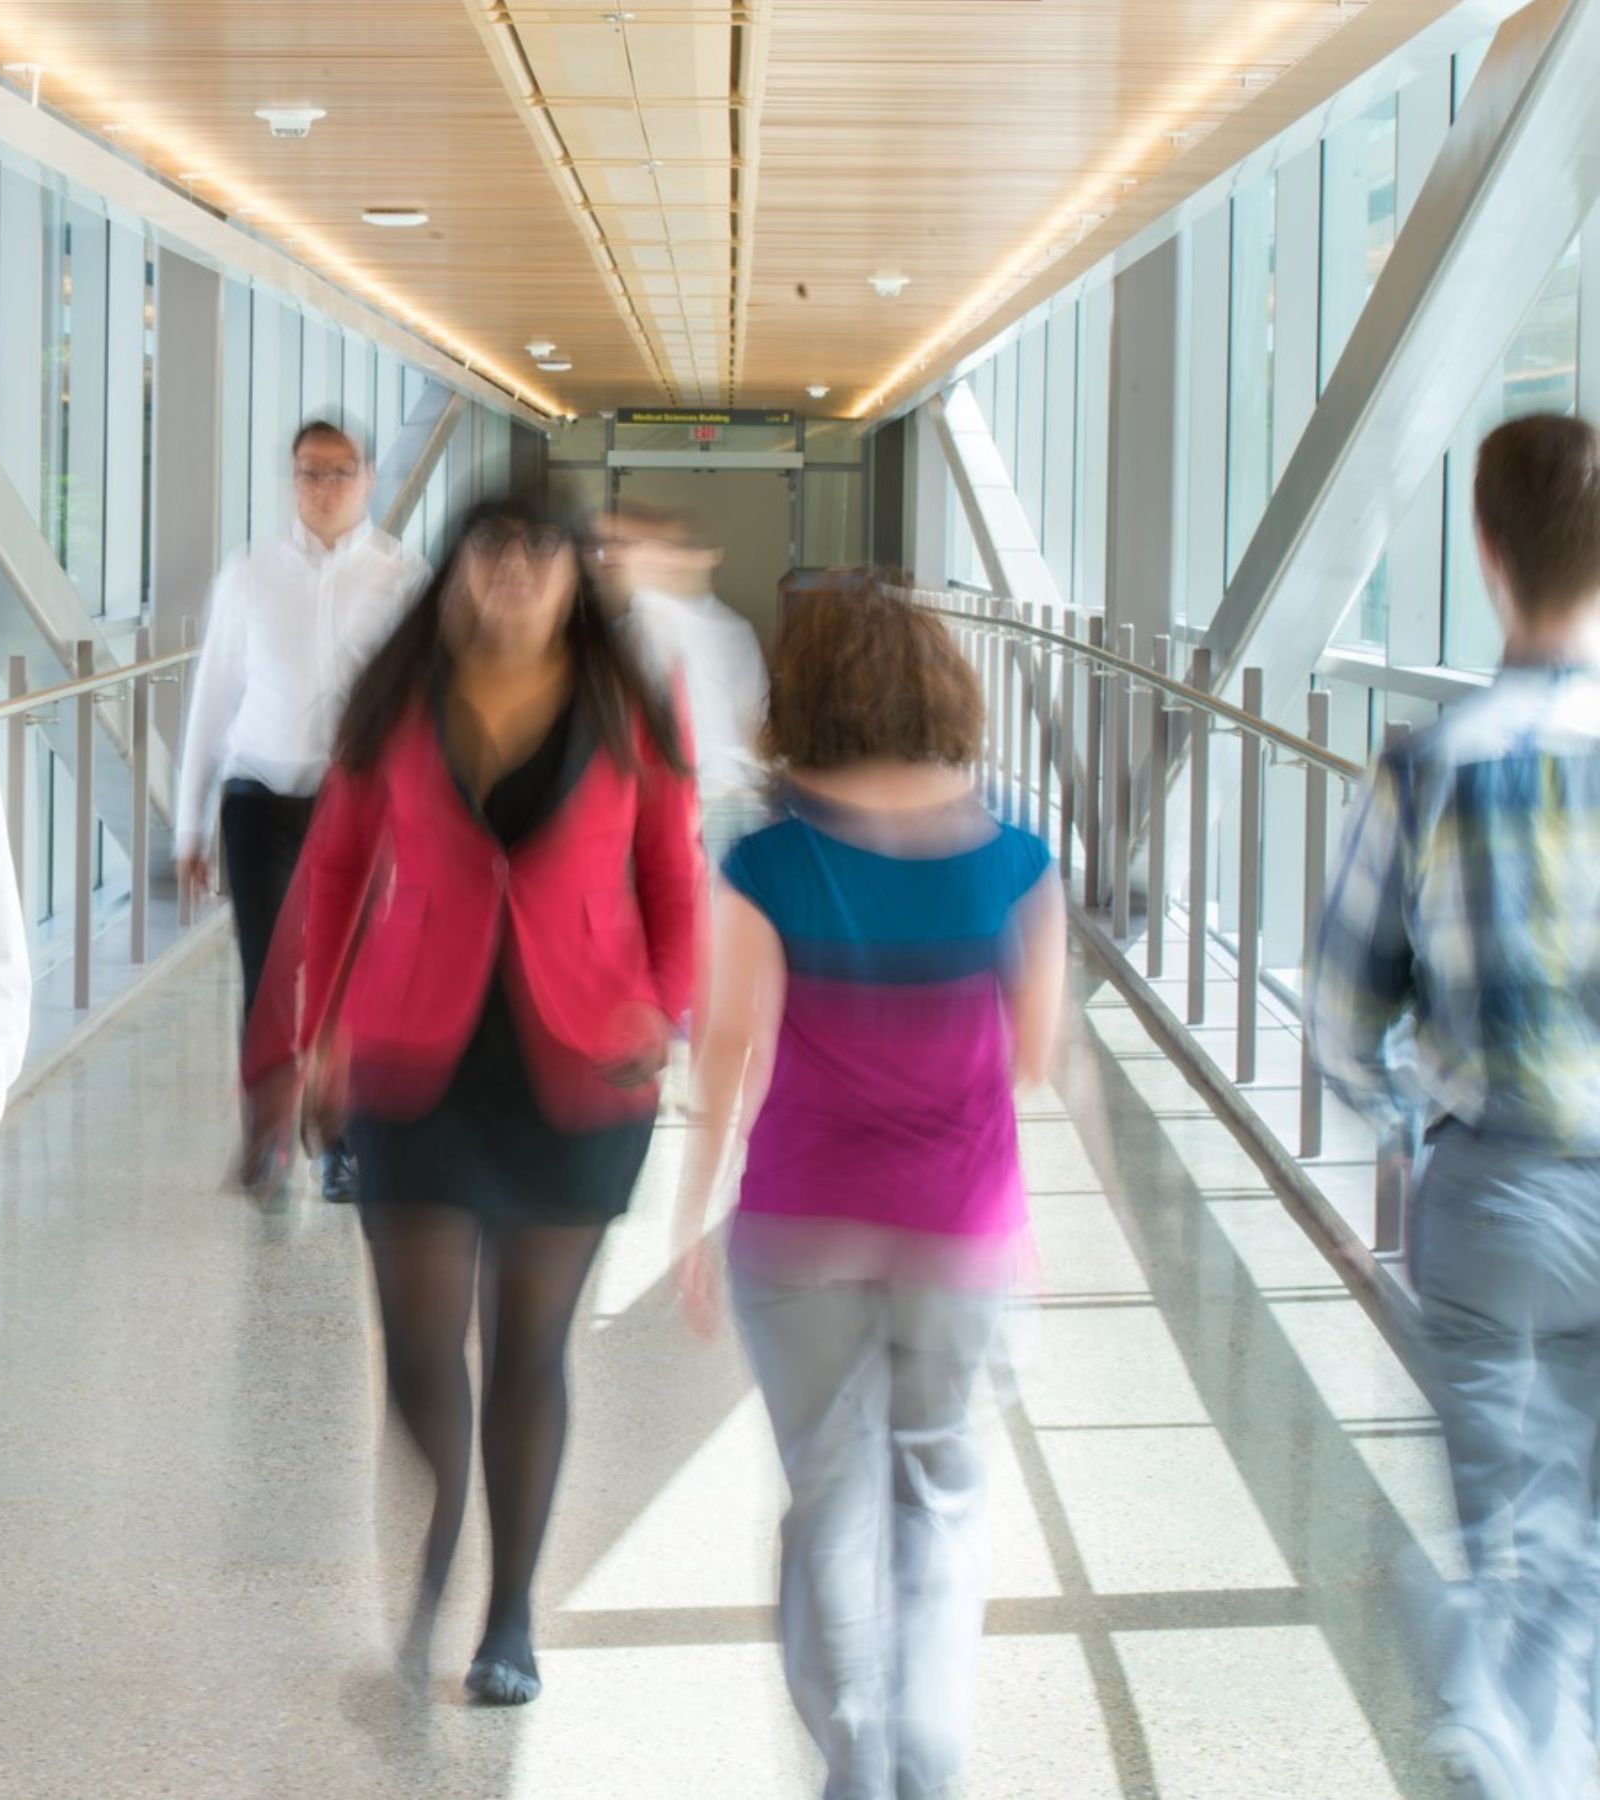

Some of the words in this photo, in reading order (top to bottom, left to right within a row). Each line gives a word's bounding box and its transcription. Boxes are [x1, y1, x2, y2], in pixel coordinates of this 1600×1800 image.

[632, 413, 662, 421] Medical
[664, 413, 697, 421] Sciences
[699, 413, 730, 424] Building
